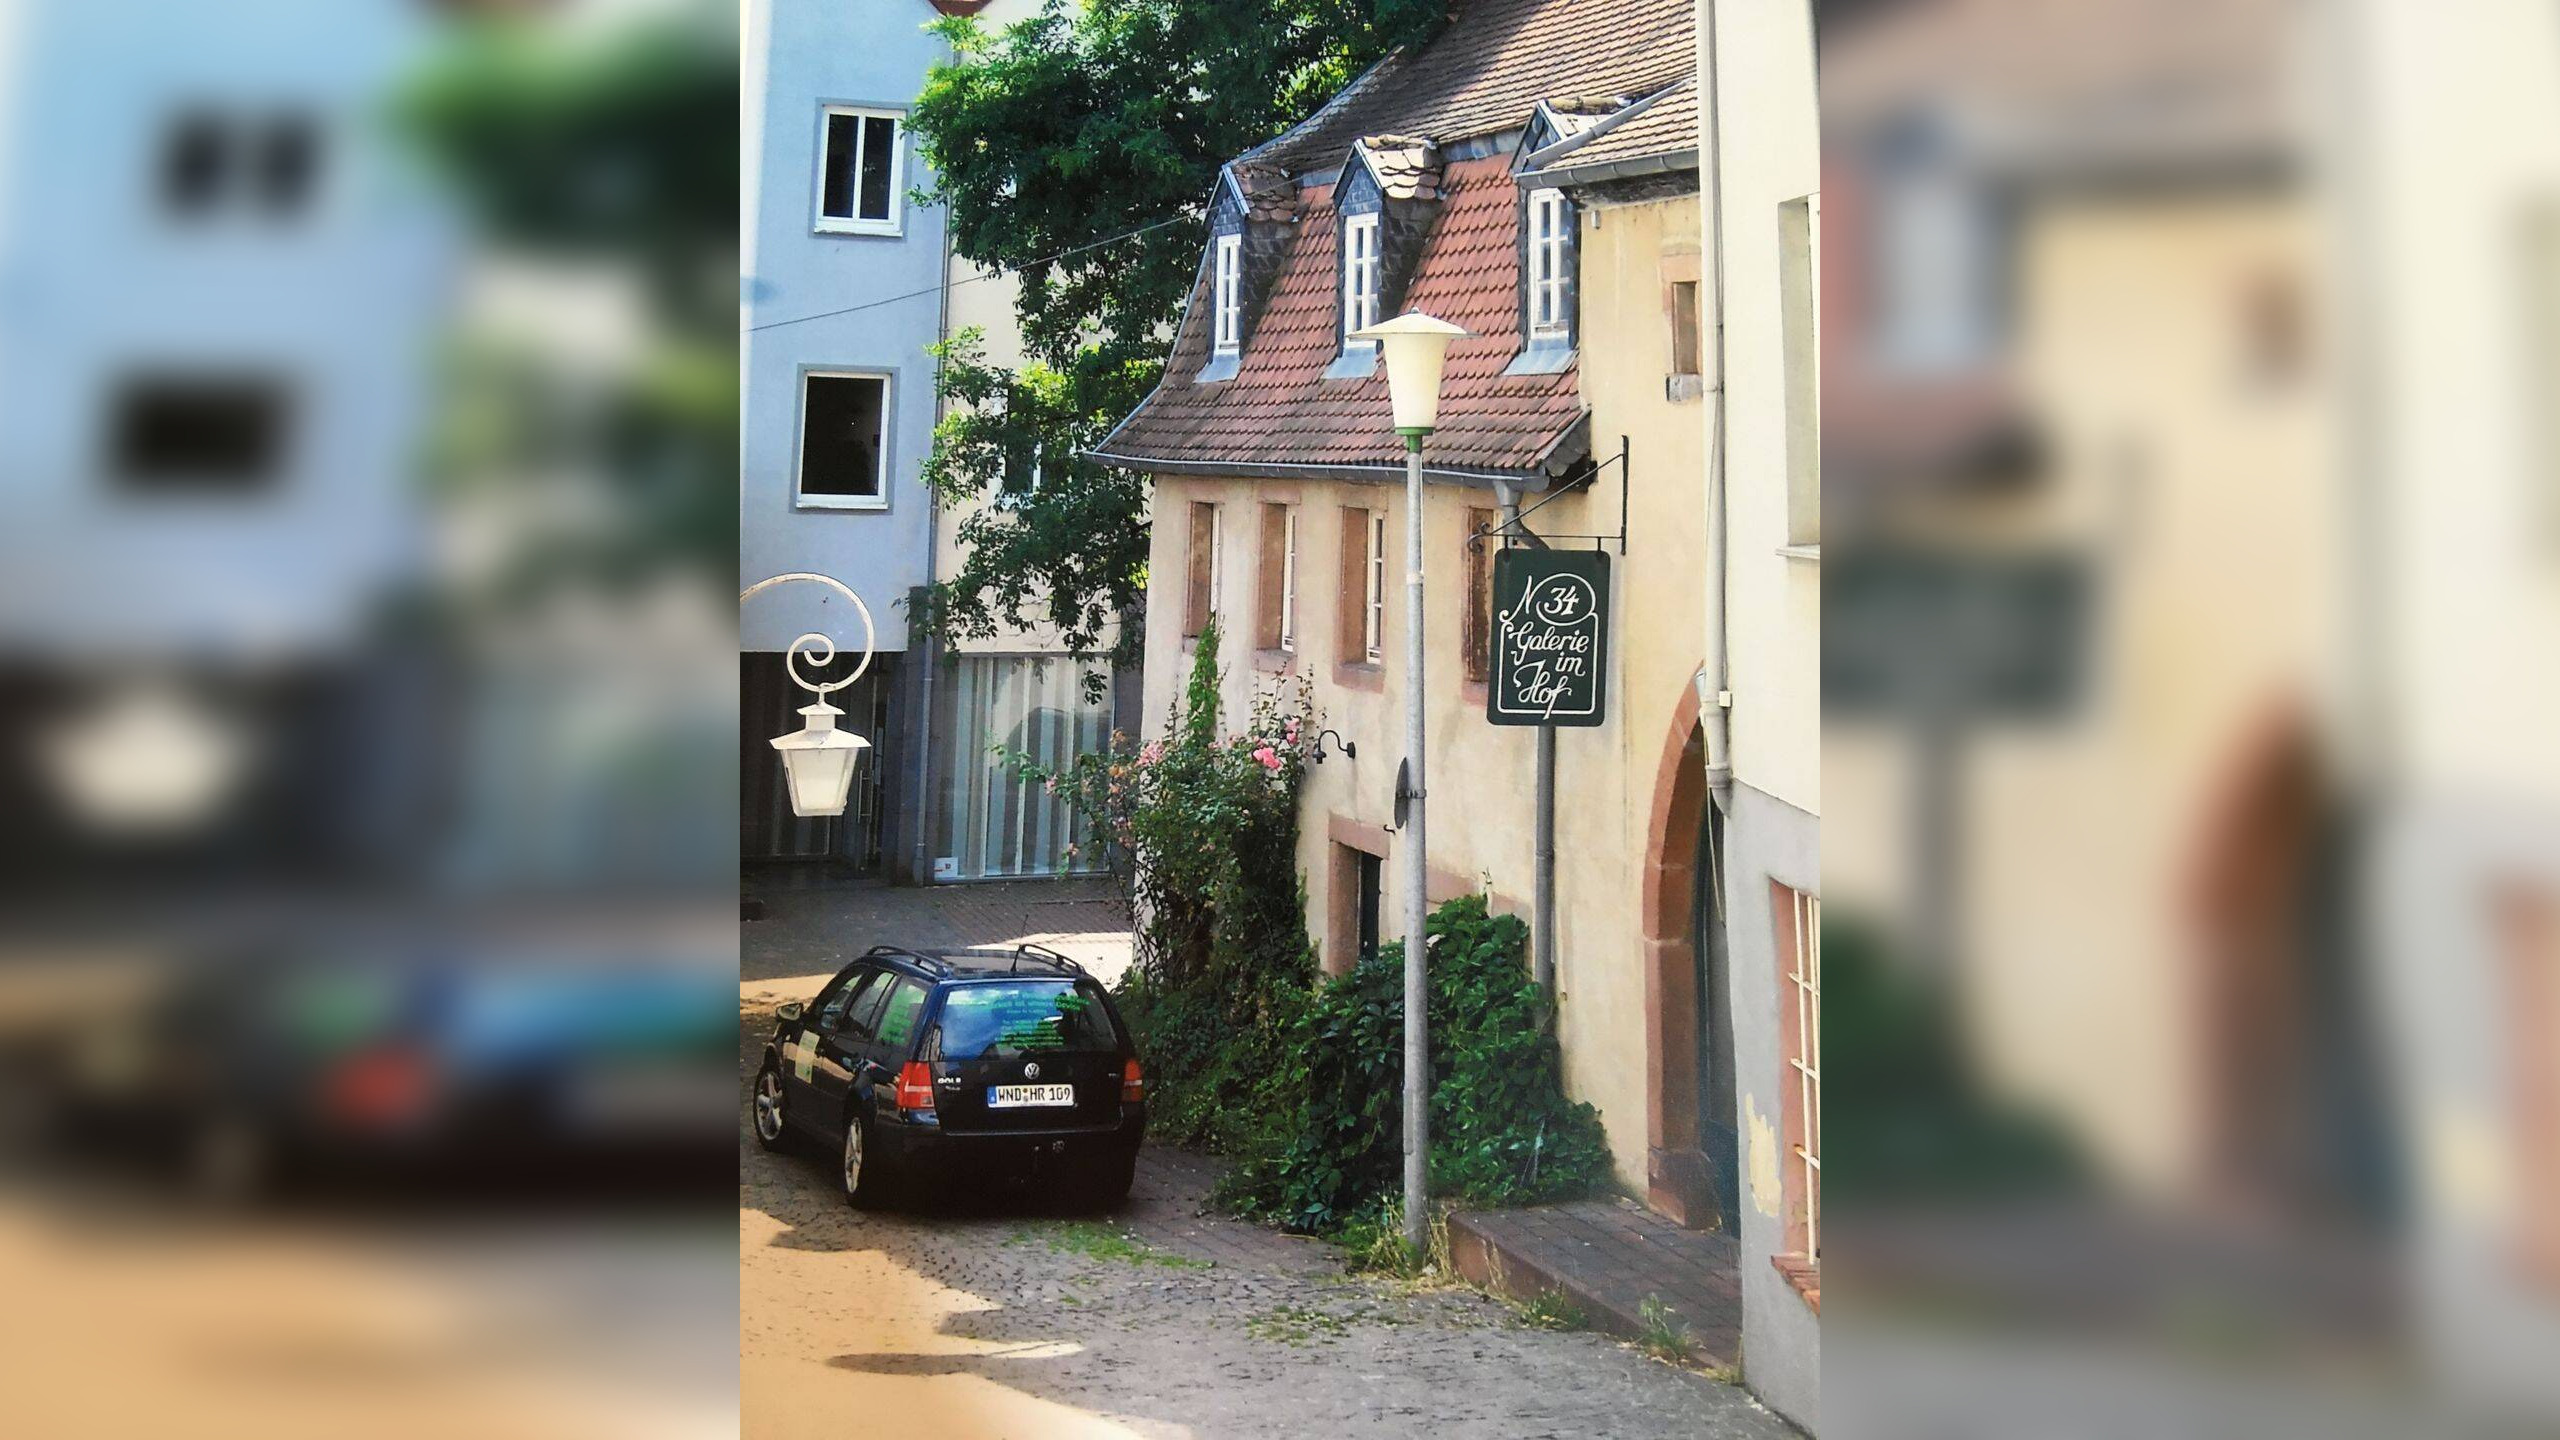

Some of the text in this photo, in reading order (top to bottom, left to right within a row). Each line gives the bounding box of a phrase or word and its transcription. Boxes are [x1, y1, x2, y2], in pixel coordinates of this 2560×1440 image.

[1543, 585, 1579, 616] 34
[1507, 621, 1589, 666] Galerie
[1555, 651, 1585, 677] im
[1512, 659, 1573, 720] Hof
[998, 1087, 1071, 1102] WND HR 109
